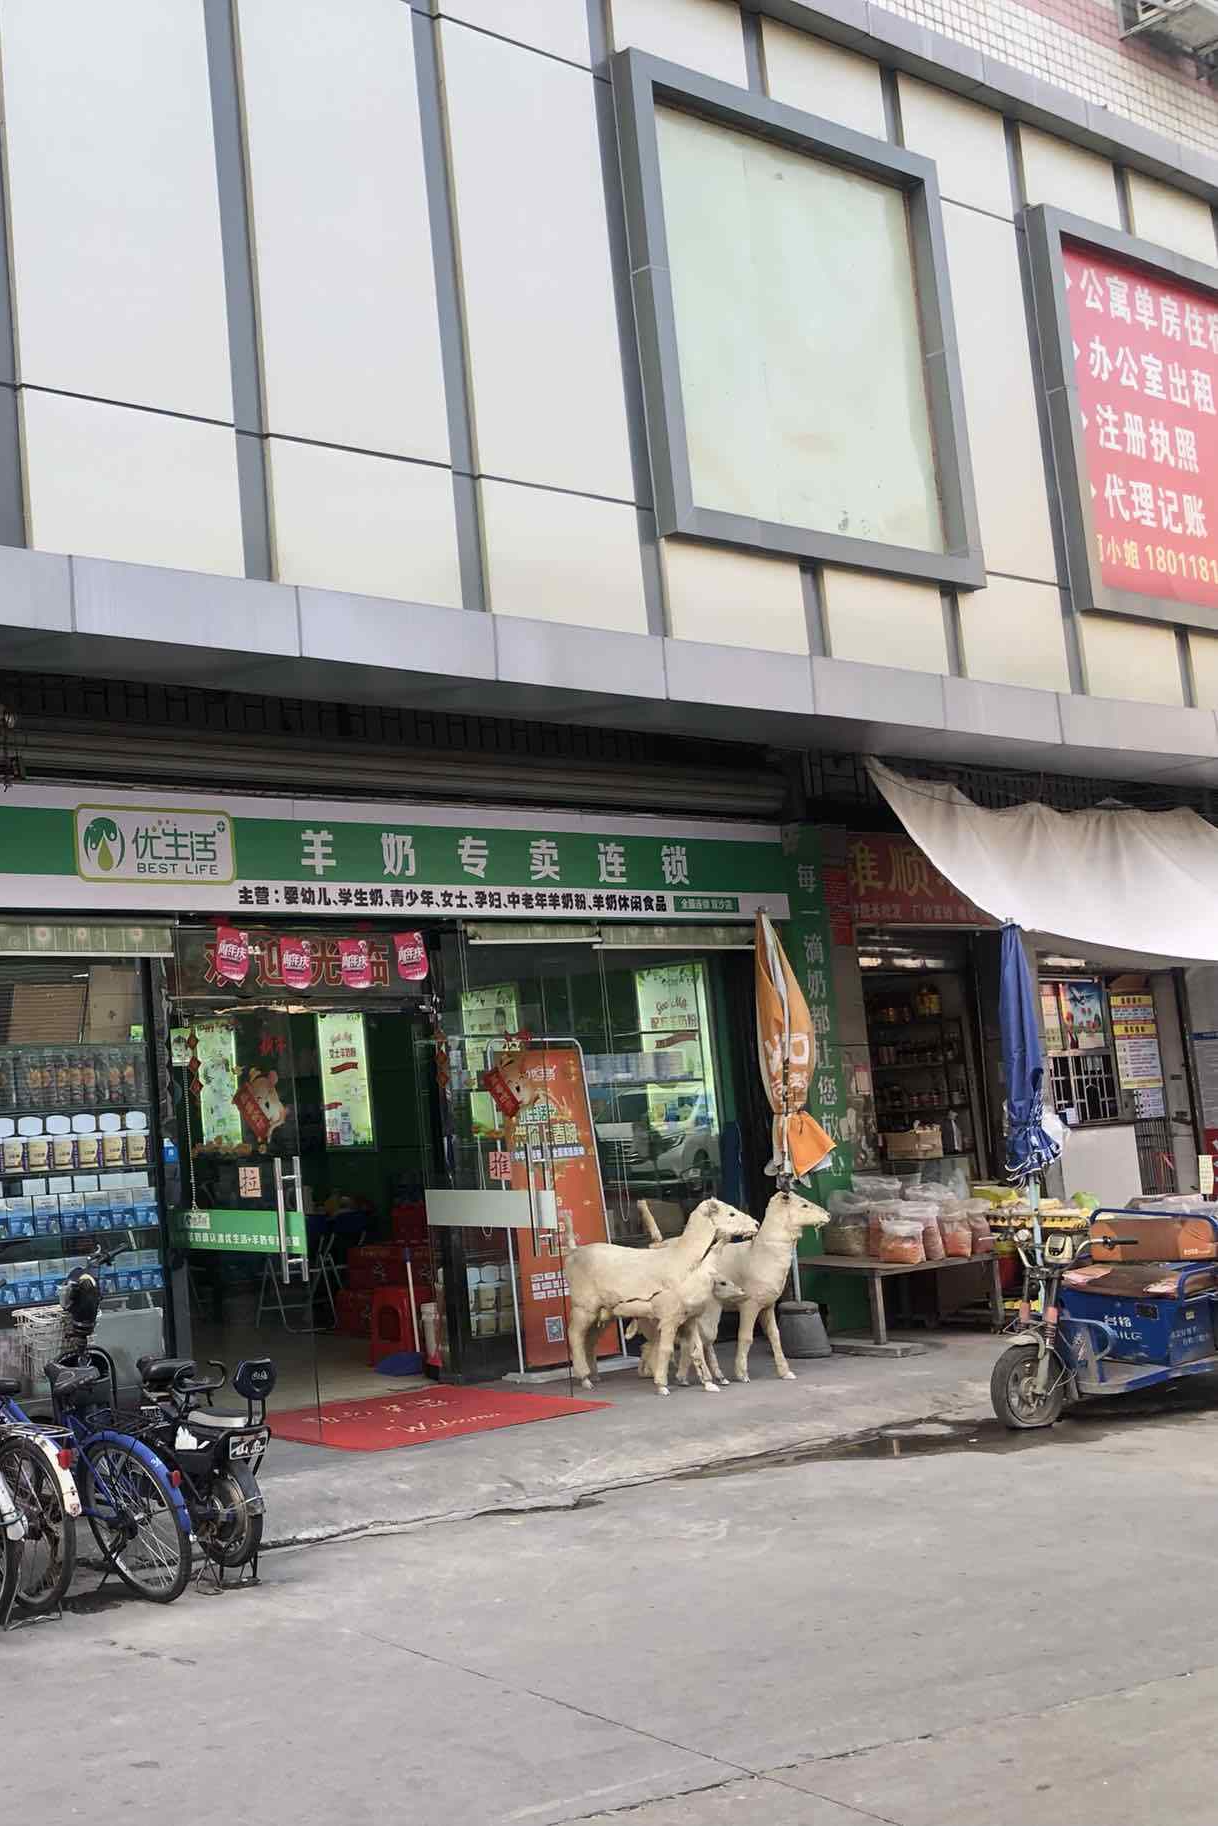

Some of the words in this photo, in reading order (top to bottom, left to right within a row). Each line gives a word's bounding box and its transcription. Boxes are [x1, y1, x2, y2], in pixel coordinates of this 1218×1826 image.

[1089, 335, 1217, 416] 办公室出租
[1096, 403, 1200, 474] 注册执照
[1104, 472, 1209, 539] 代理记账
[131, 824, 217, 863] 优生活
[301, 828, 691, 886] 羊奶专卖连锁
[137, 862, 178, 875] BEST
[185, 863, 219, 876] LIFE
[240, 1168, 261, 1195] 拉
[489, 1152, 511, 1178] 推
